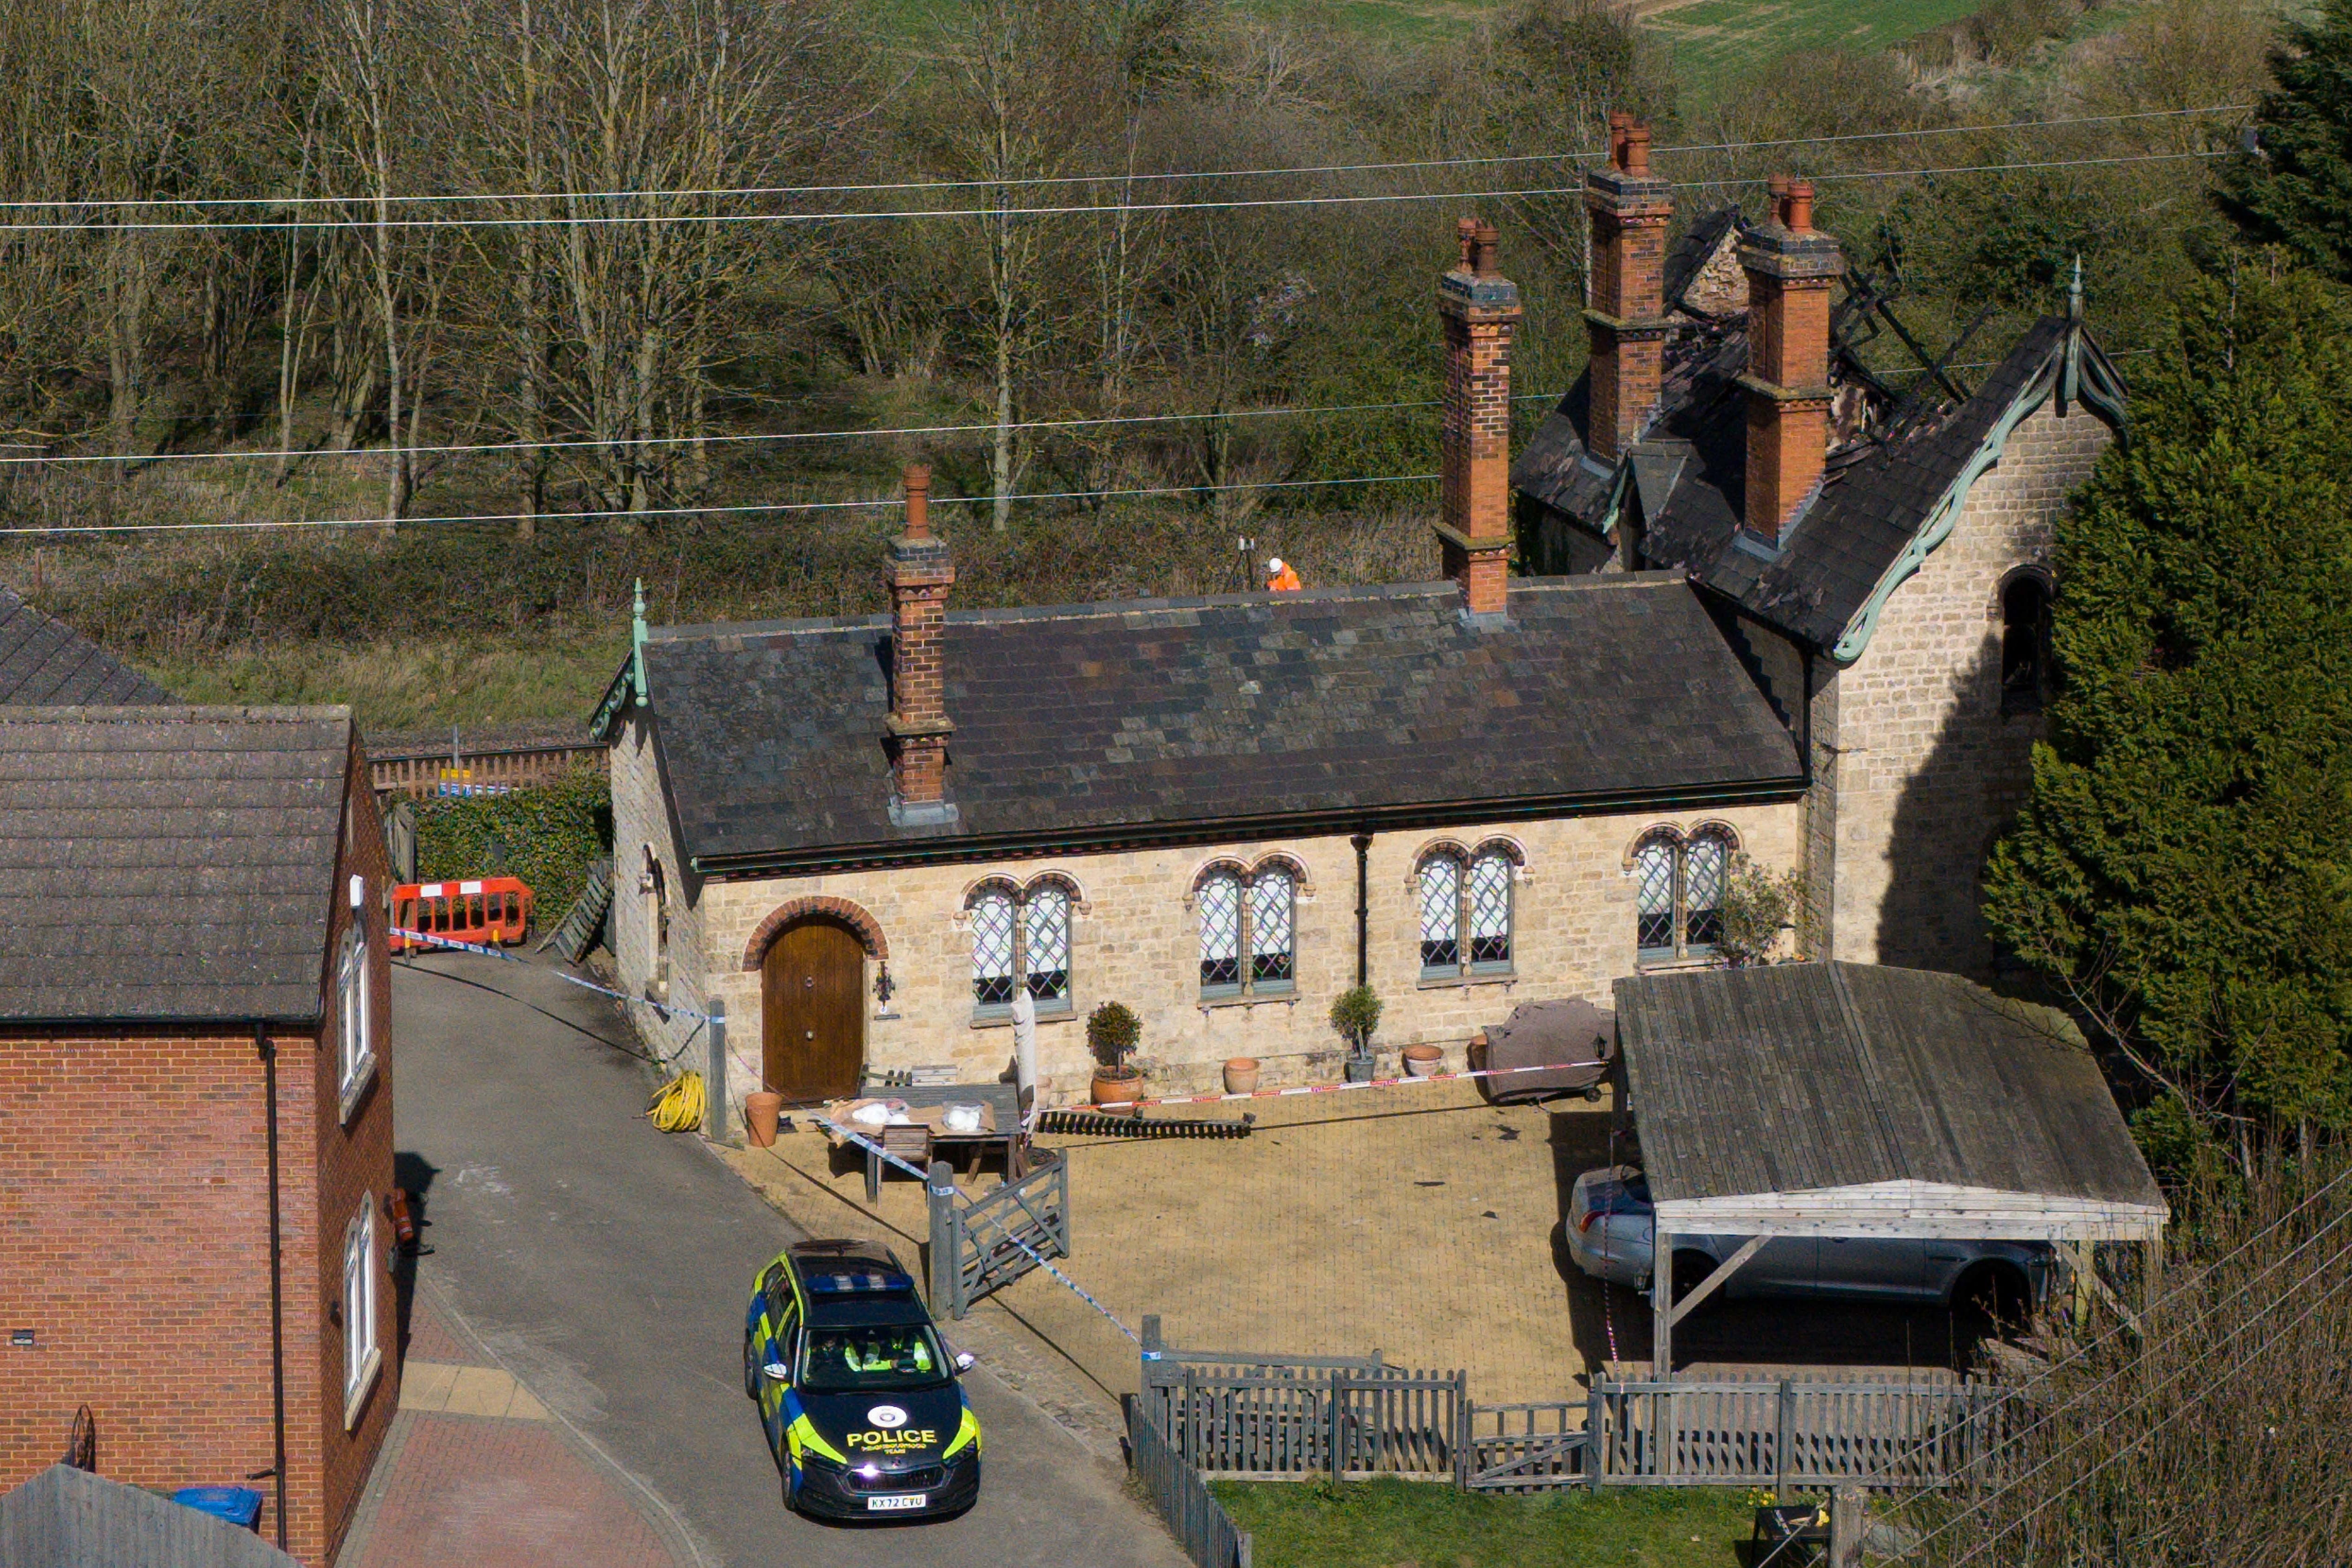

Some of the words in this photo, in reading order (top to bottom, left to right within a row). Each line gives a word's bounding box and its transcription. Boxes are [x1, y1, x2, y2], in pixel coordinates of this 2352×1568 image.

[847, 1430, 937, 1447] POLICE
[872, 1498, 899, 1508] KX72
[902, 1497, 922, 1506] CVU
